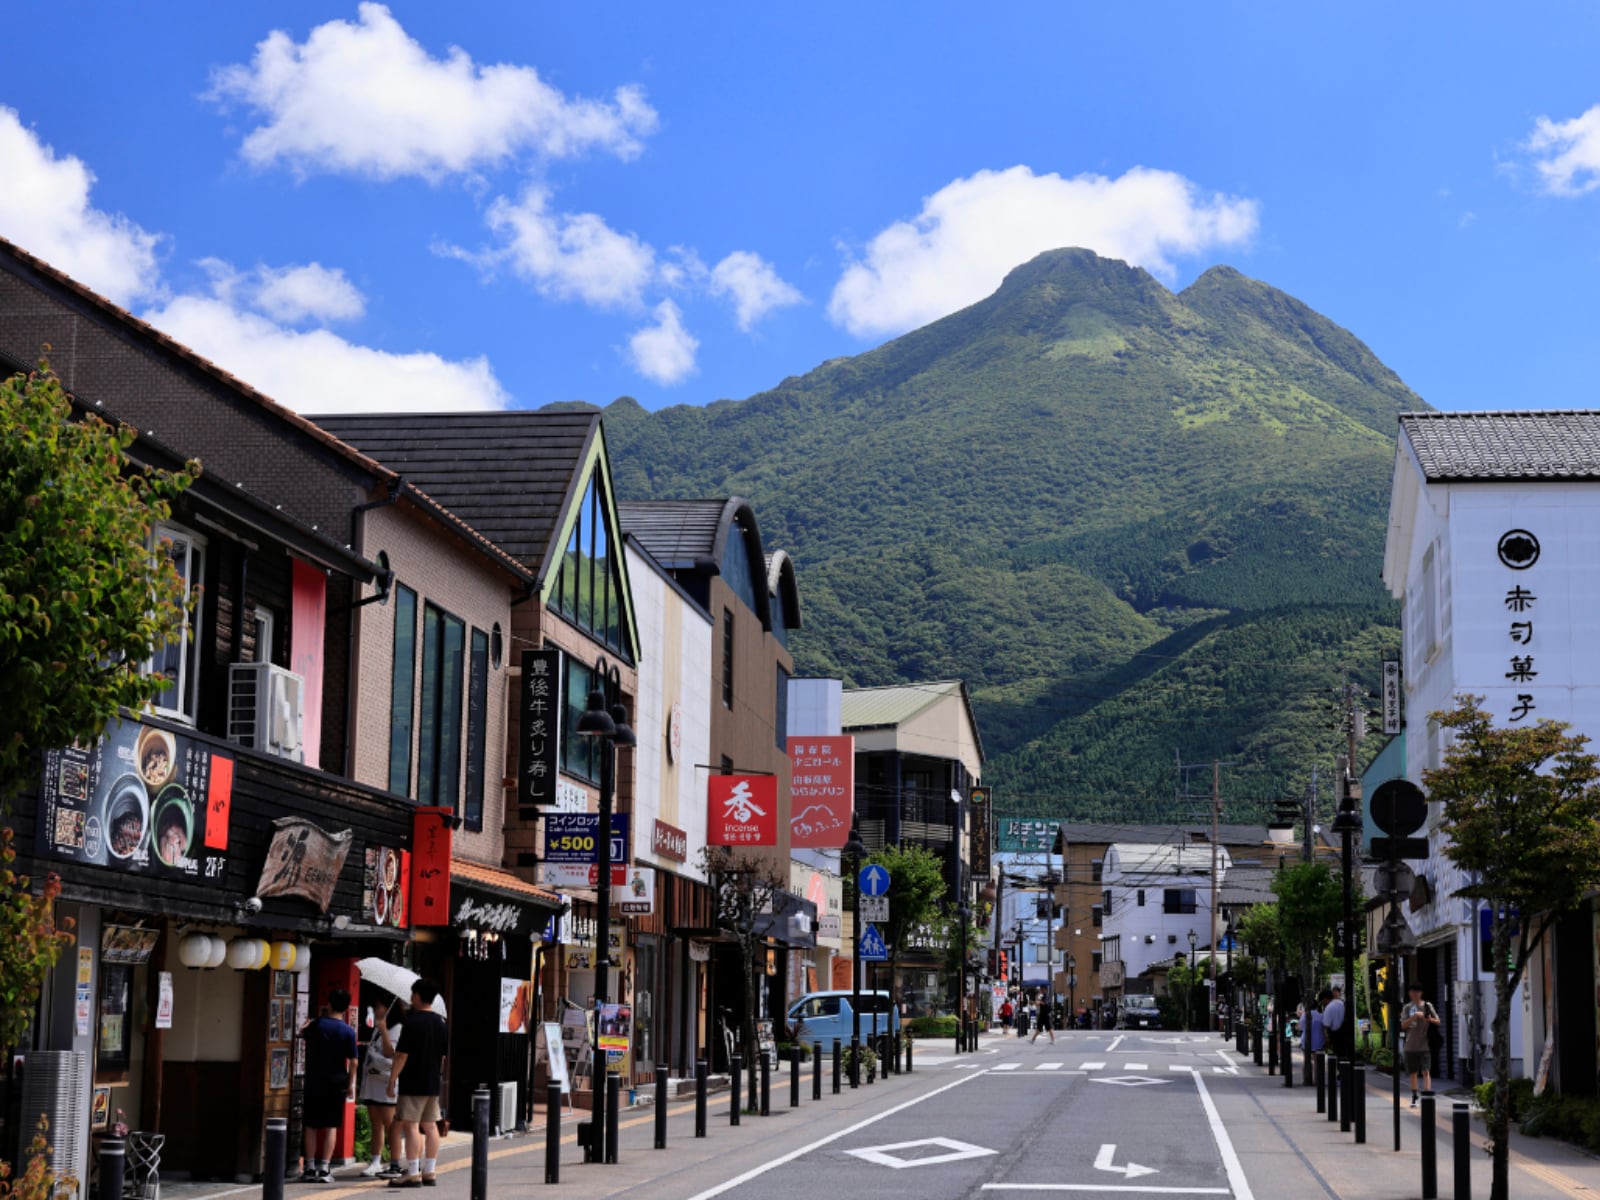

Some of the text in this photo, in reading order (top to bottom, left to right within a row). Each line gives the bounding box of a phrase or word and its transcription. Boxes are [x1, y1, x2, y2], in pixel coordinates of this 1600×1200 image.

[1505, 585, 1538, 722] 赤司菓子
[528, 659, 550, 797] 豊後牛炙り寿し
[722, 781, 767, 823] 香
[549, 816, 614, 826] コインロッカ
[725, 823, 759, 832] incense
[1007, 821, 1060, 836] パチンコ
[550, 836, 595, 851] ¥500
